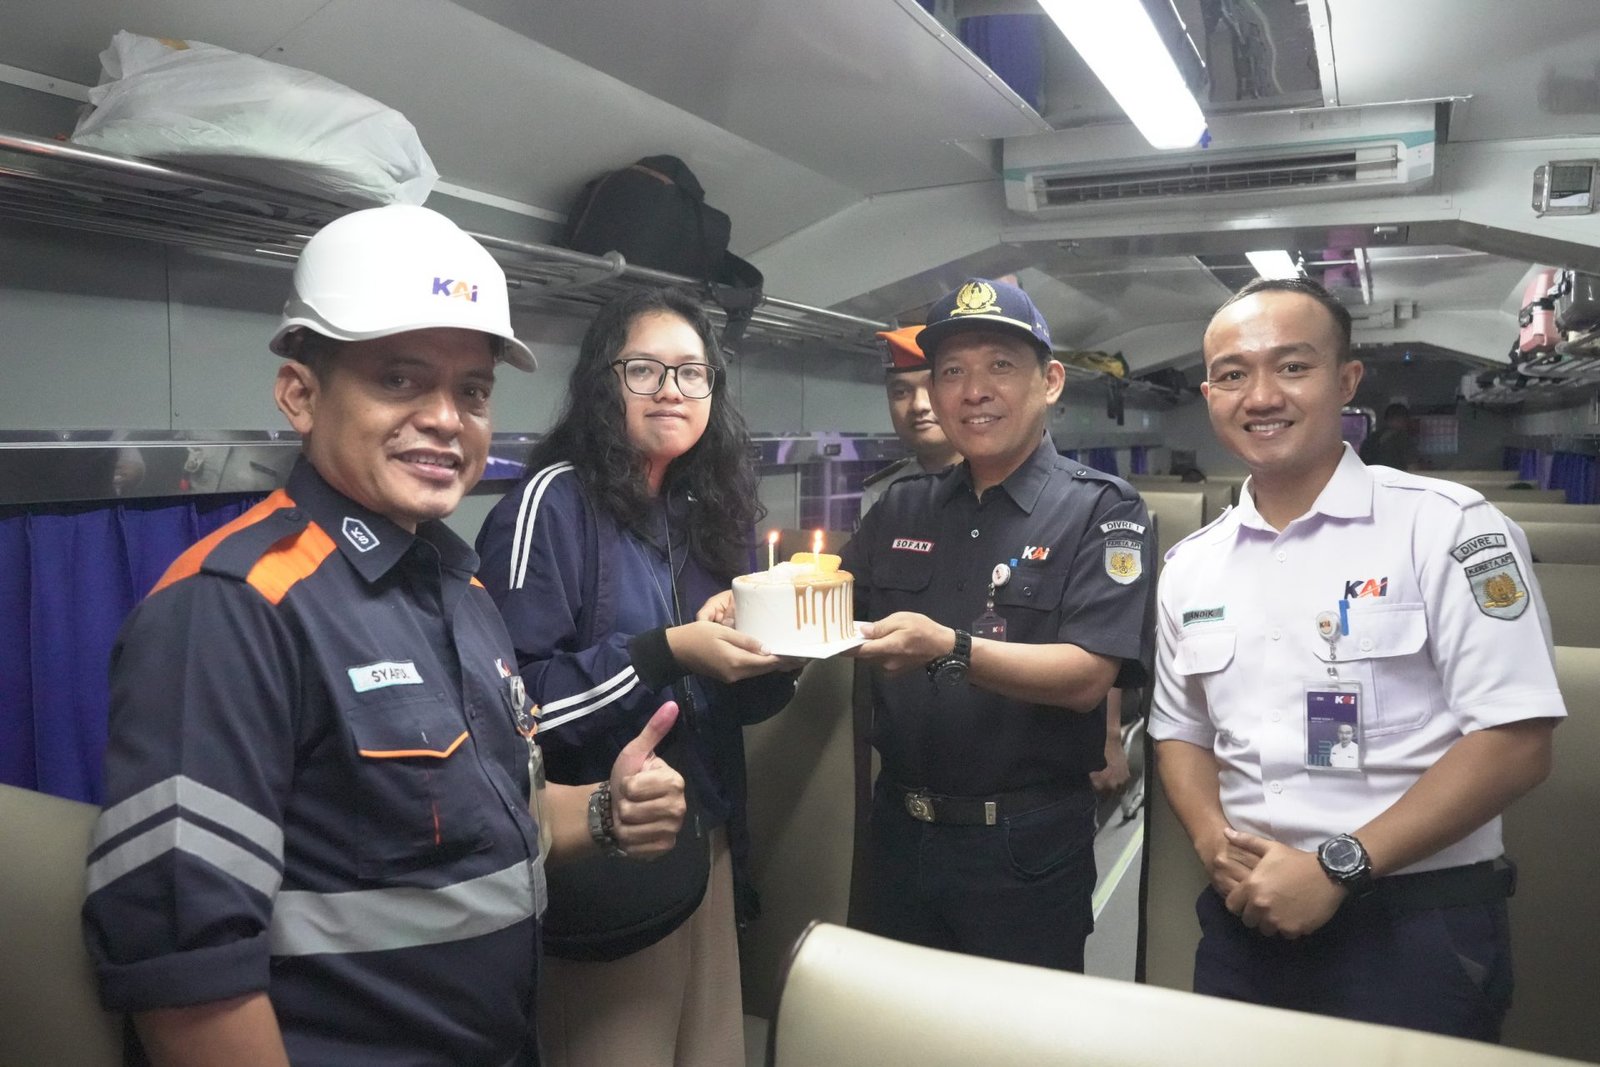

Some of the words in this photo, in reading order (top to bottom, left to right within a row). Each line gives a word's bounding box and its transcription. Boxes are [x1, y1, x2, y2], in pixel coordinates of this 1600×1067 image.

[350, 526, 370, 545] KS
[896, 540, 929, 550] SOFAN
[1460, 536, 1492, 555] DIVRE
[1468, 560, 1499, 574] KERETA
